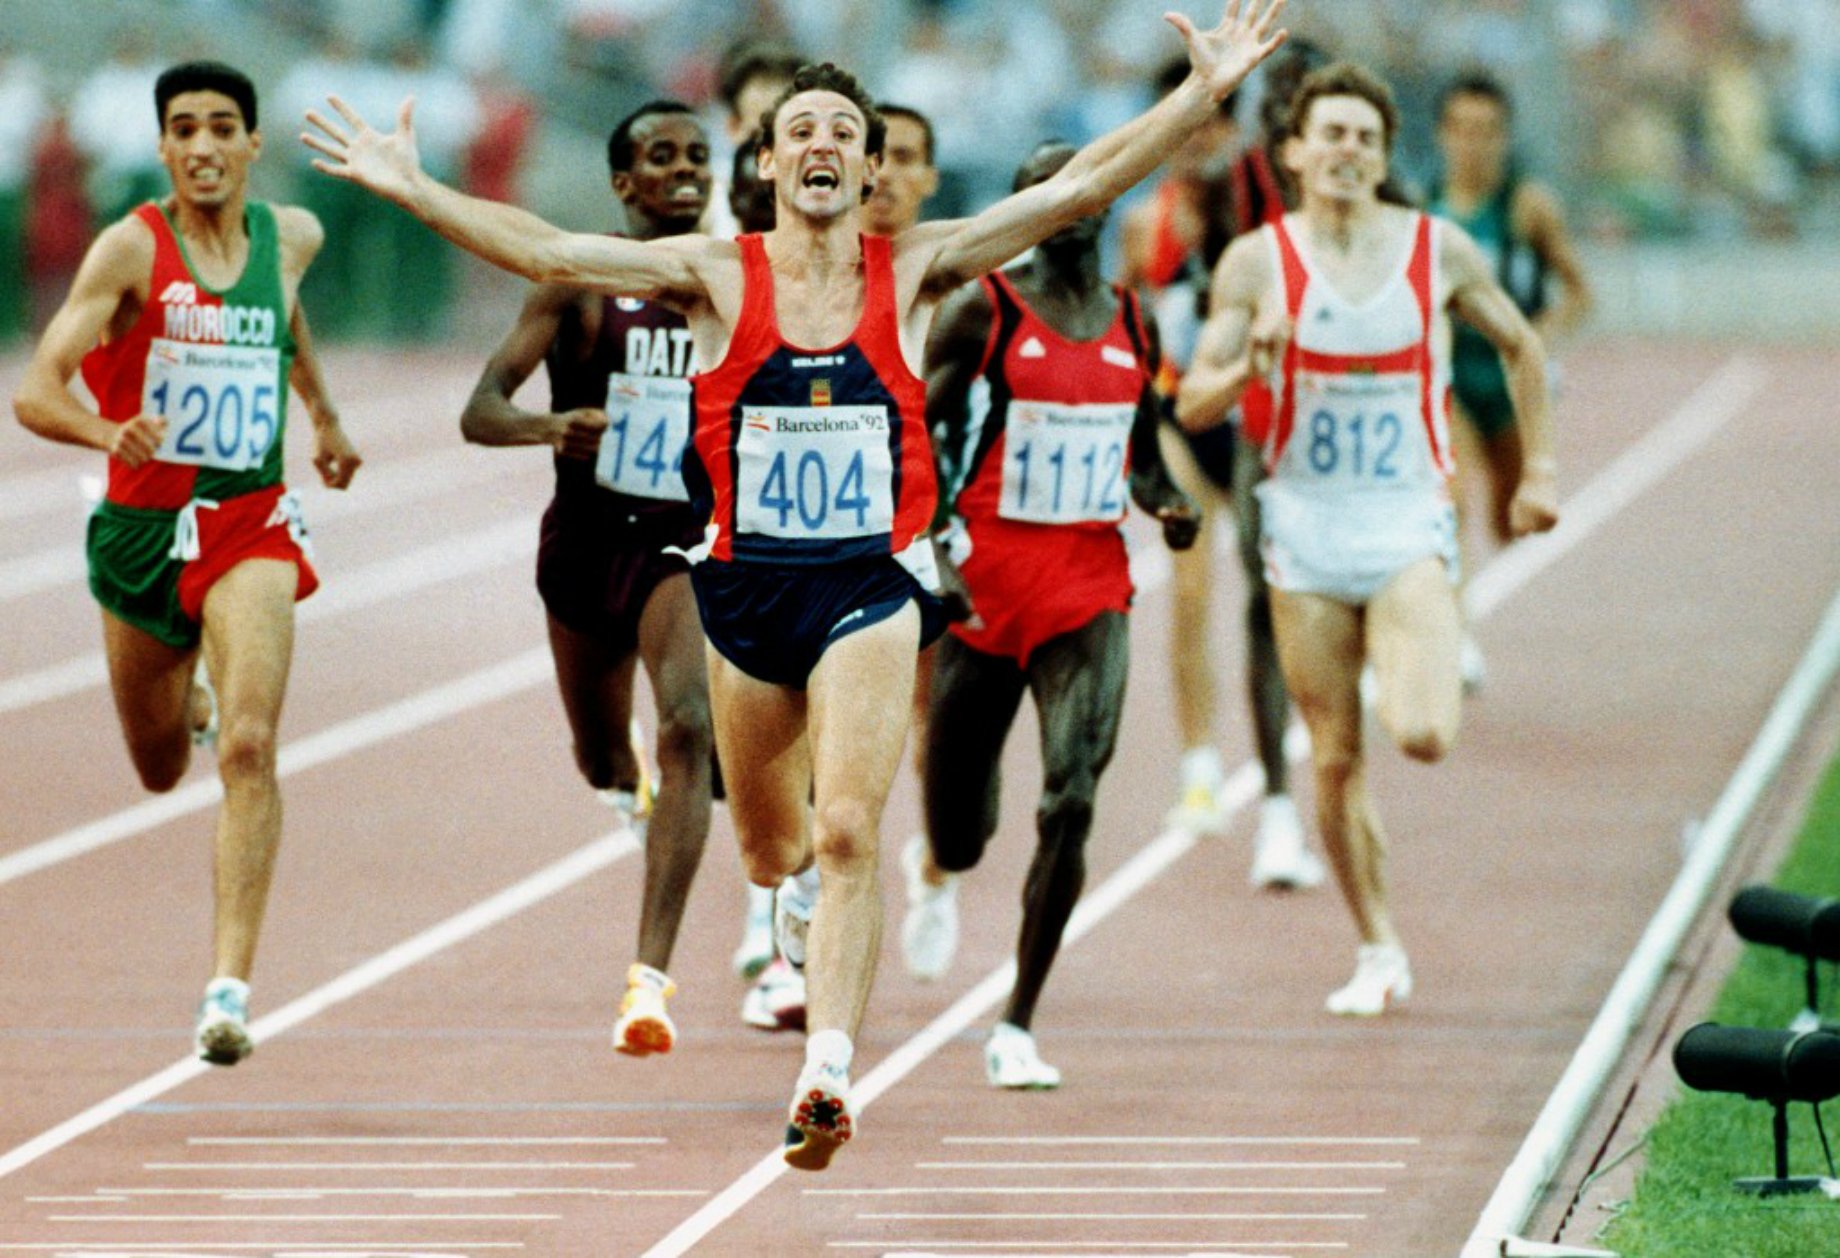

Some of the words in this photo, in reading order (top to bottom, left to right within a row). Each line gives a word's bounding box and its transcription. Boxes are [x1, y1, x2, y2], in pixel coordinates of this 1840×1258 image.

[164, 304, 275, 346] MOROCCO
[152, 377, 274, 459] 1205
[603, 412, 682, 487] 14
[775, 416, 859, 433] Barcelona
[1309, 409, 1402, 476] 812
[758, 450, 871, 531] 404
[1015, 441, 1122, 513] 1112
